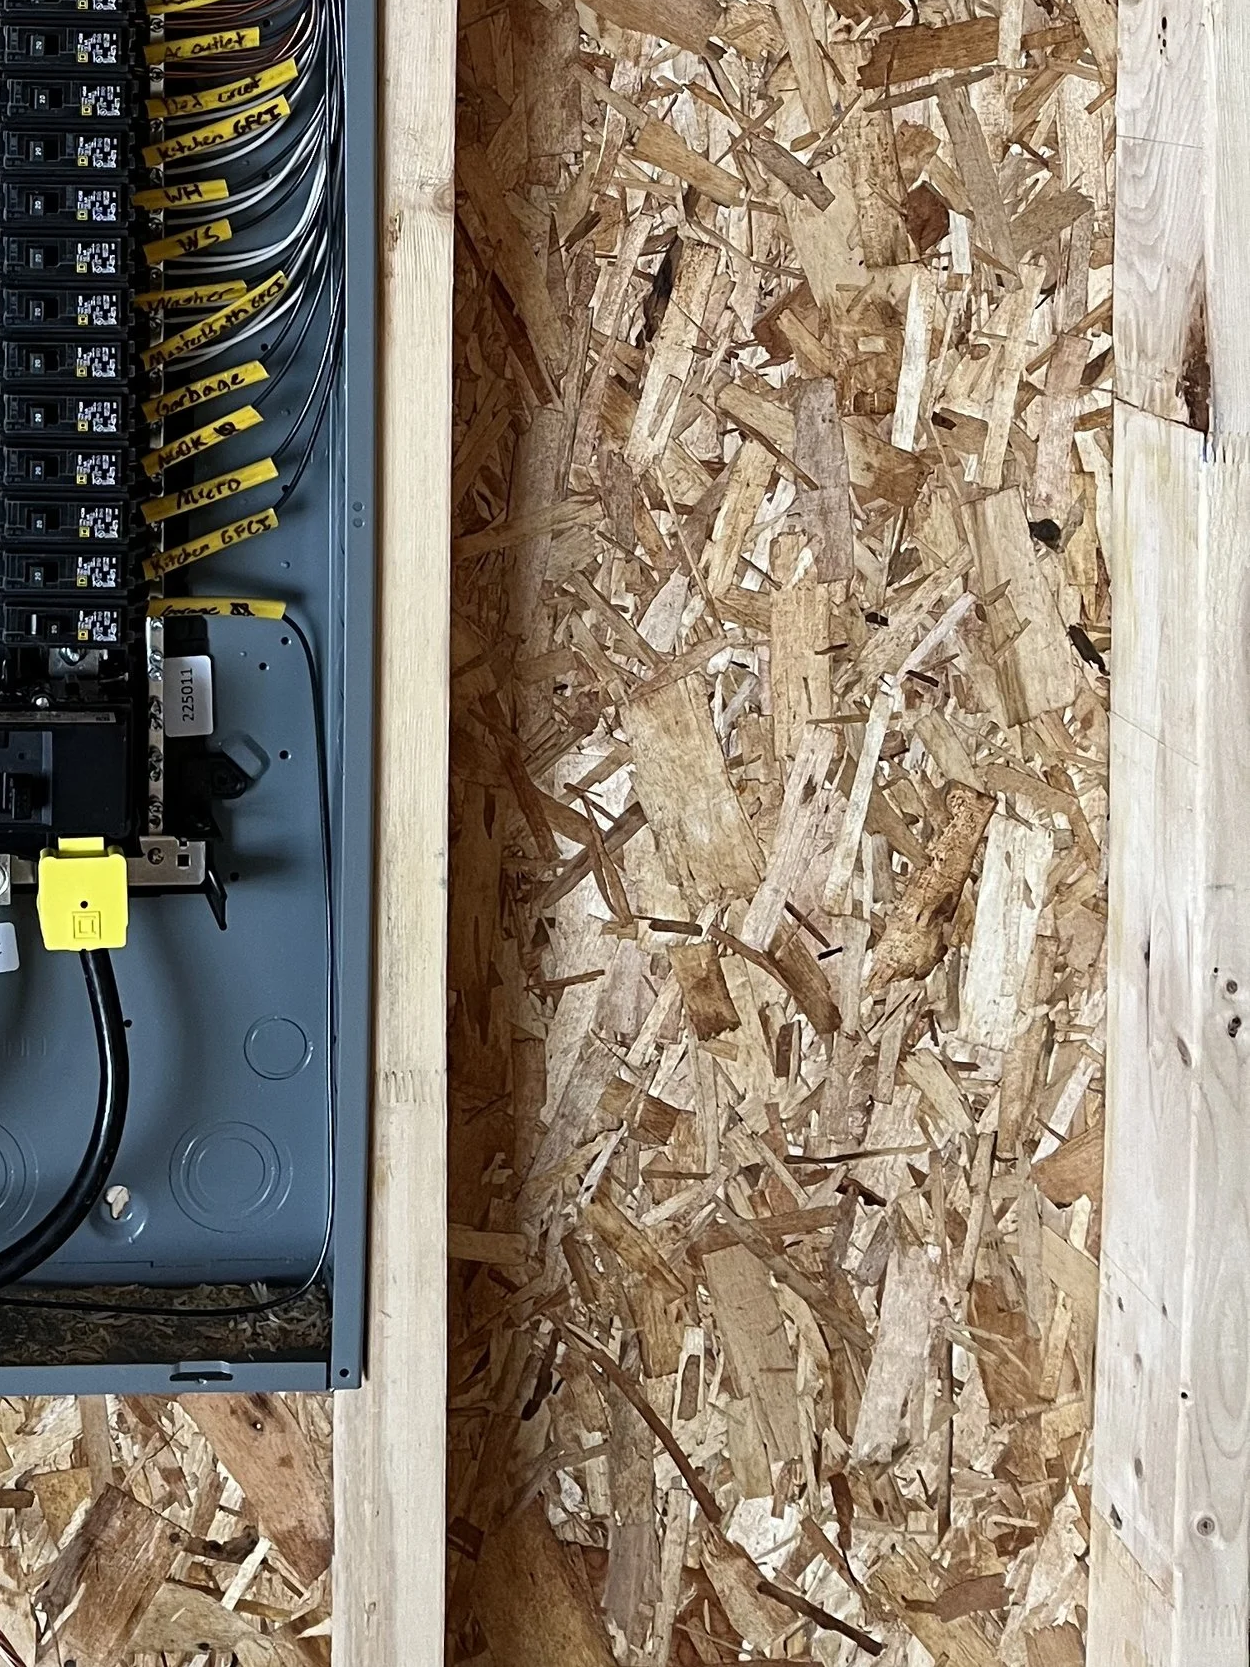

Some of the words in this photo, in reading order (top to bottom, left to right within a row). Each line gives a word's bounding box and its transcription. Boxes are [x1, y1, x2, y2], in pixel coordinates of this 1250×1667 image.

[233, 103, 282, 135] GFCI
[163, 183, 204, 204] WH
[220, 515, 272, 546] GFCI
[181, 667, 195, 724] 225011
